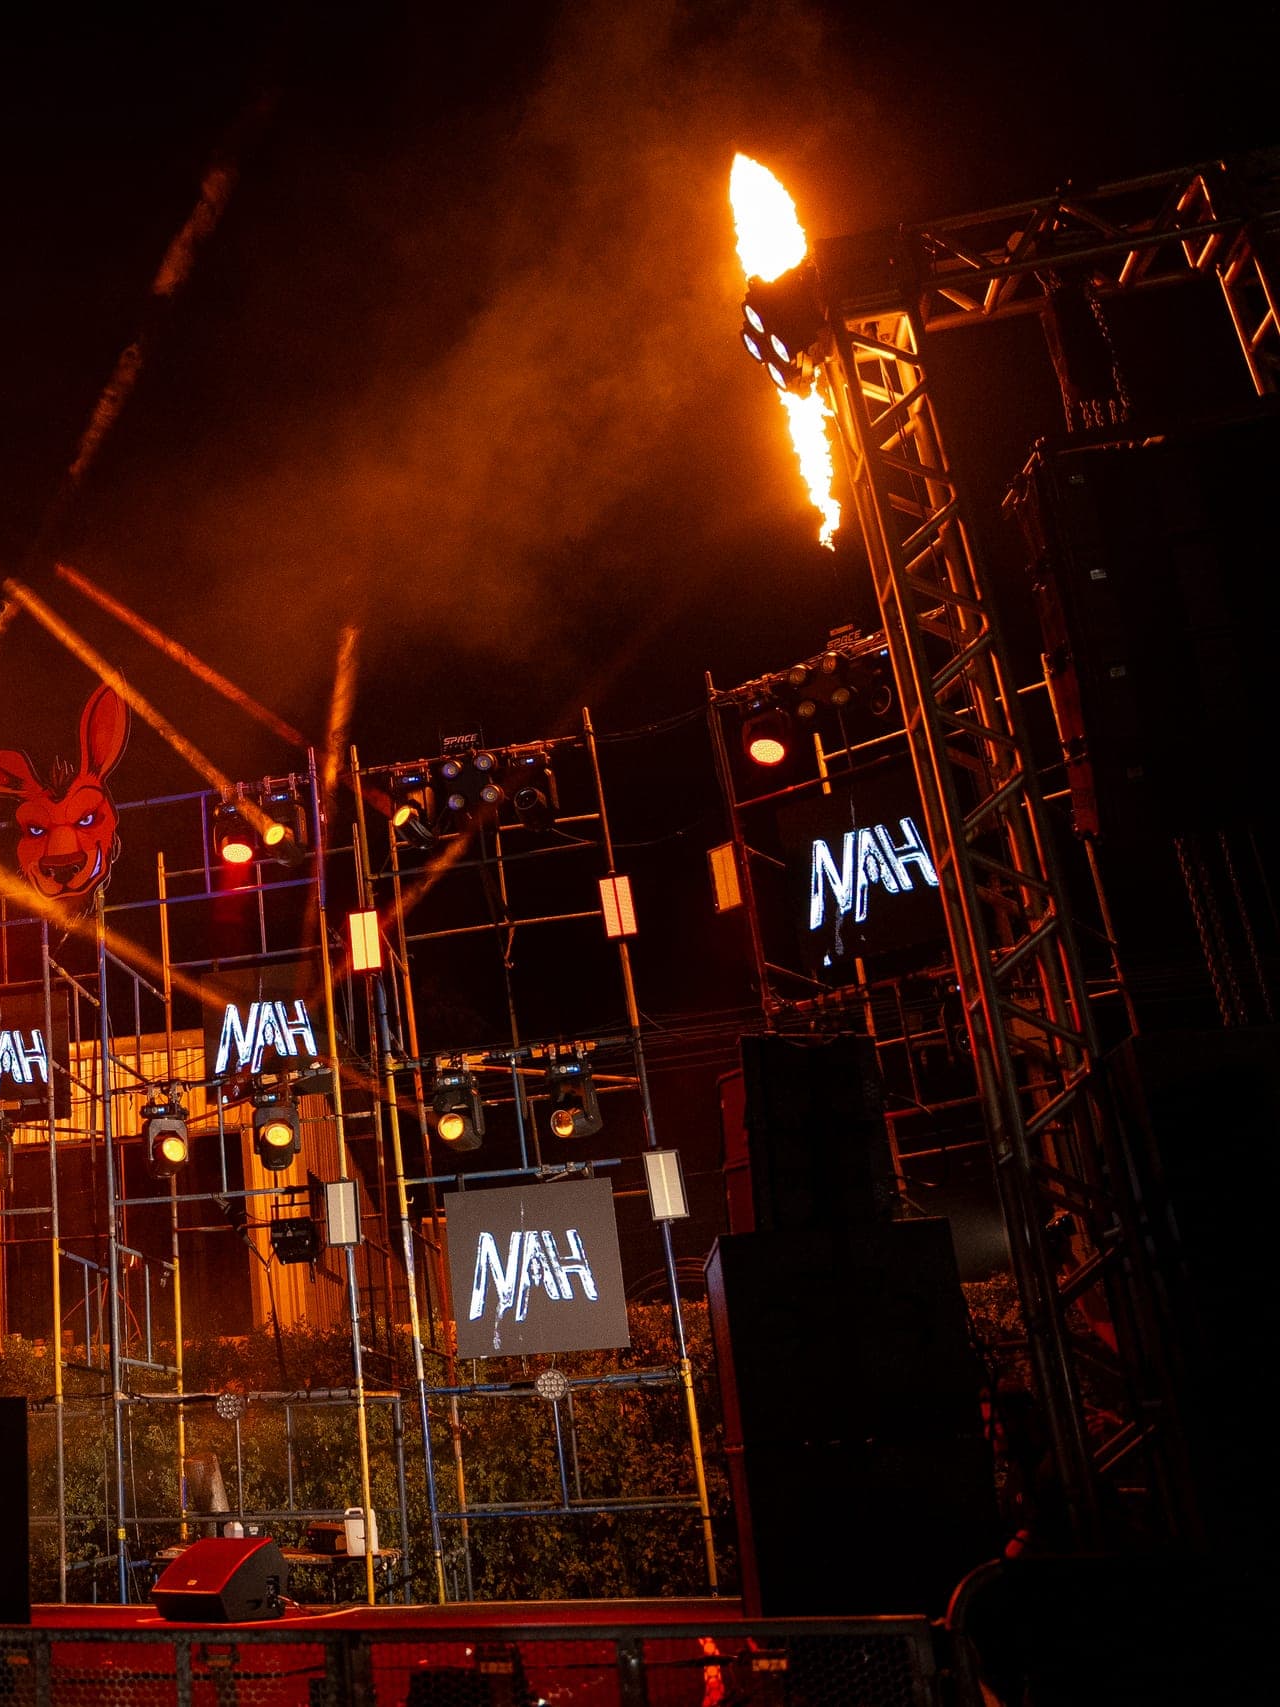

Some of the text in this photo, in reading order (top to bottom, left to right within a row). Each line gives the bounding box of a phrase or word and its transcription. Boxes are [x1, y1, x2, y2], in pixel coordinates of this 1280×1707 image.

[443, 733, 478, 746] SPACE
[810, 817, 940, 930] NAH
[215, 999, 318, 1074] NAH
[469, 1229, 599, 1322] NAH
